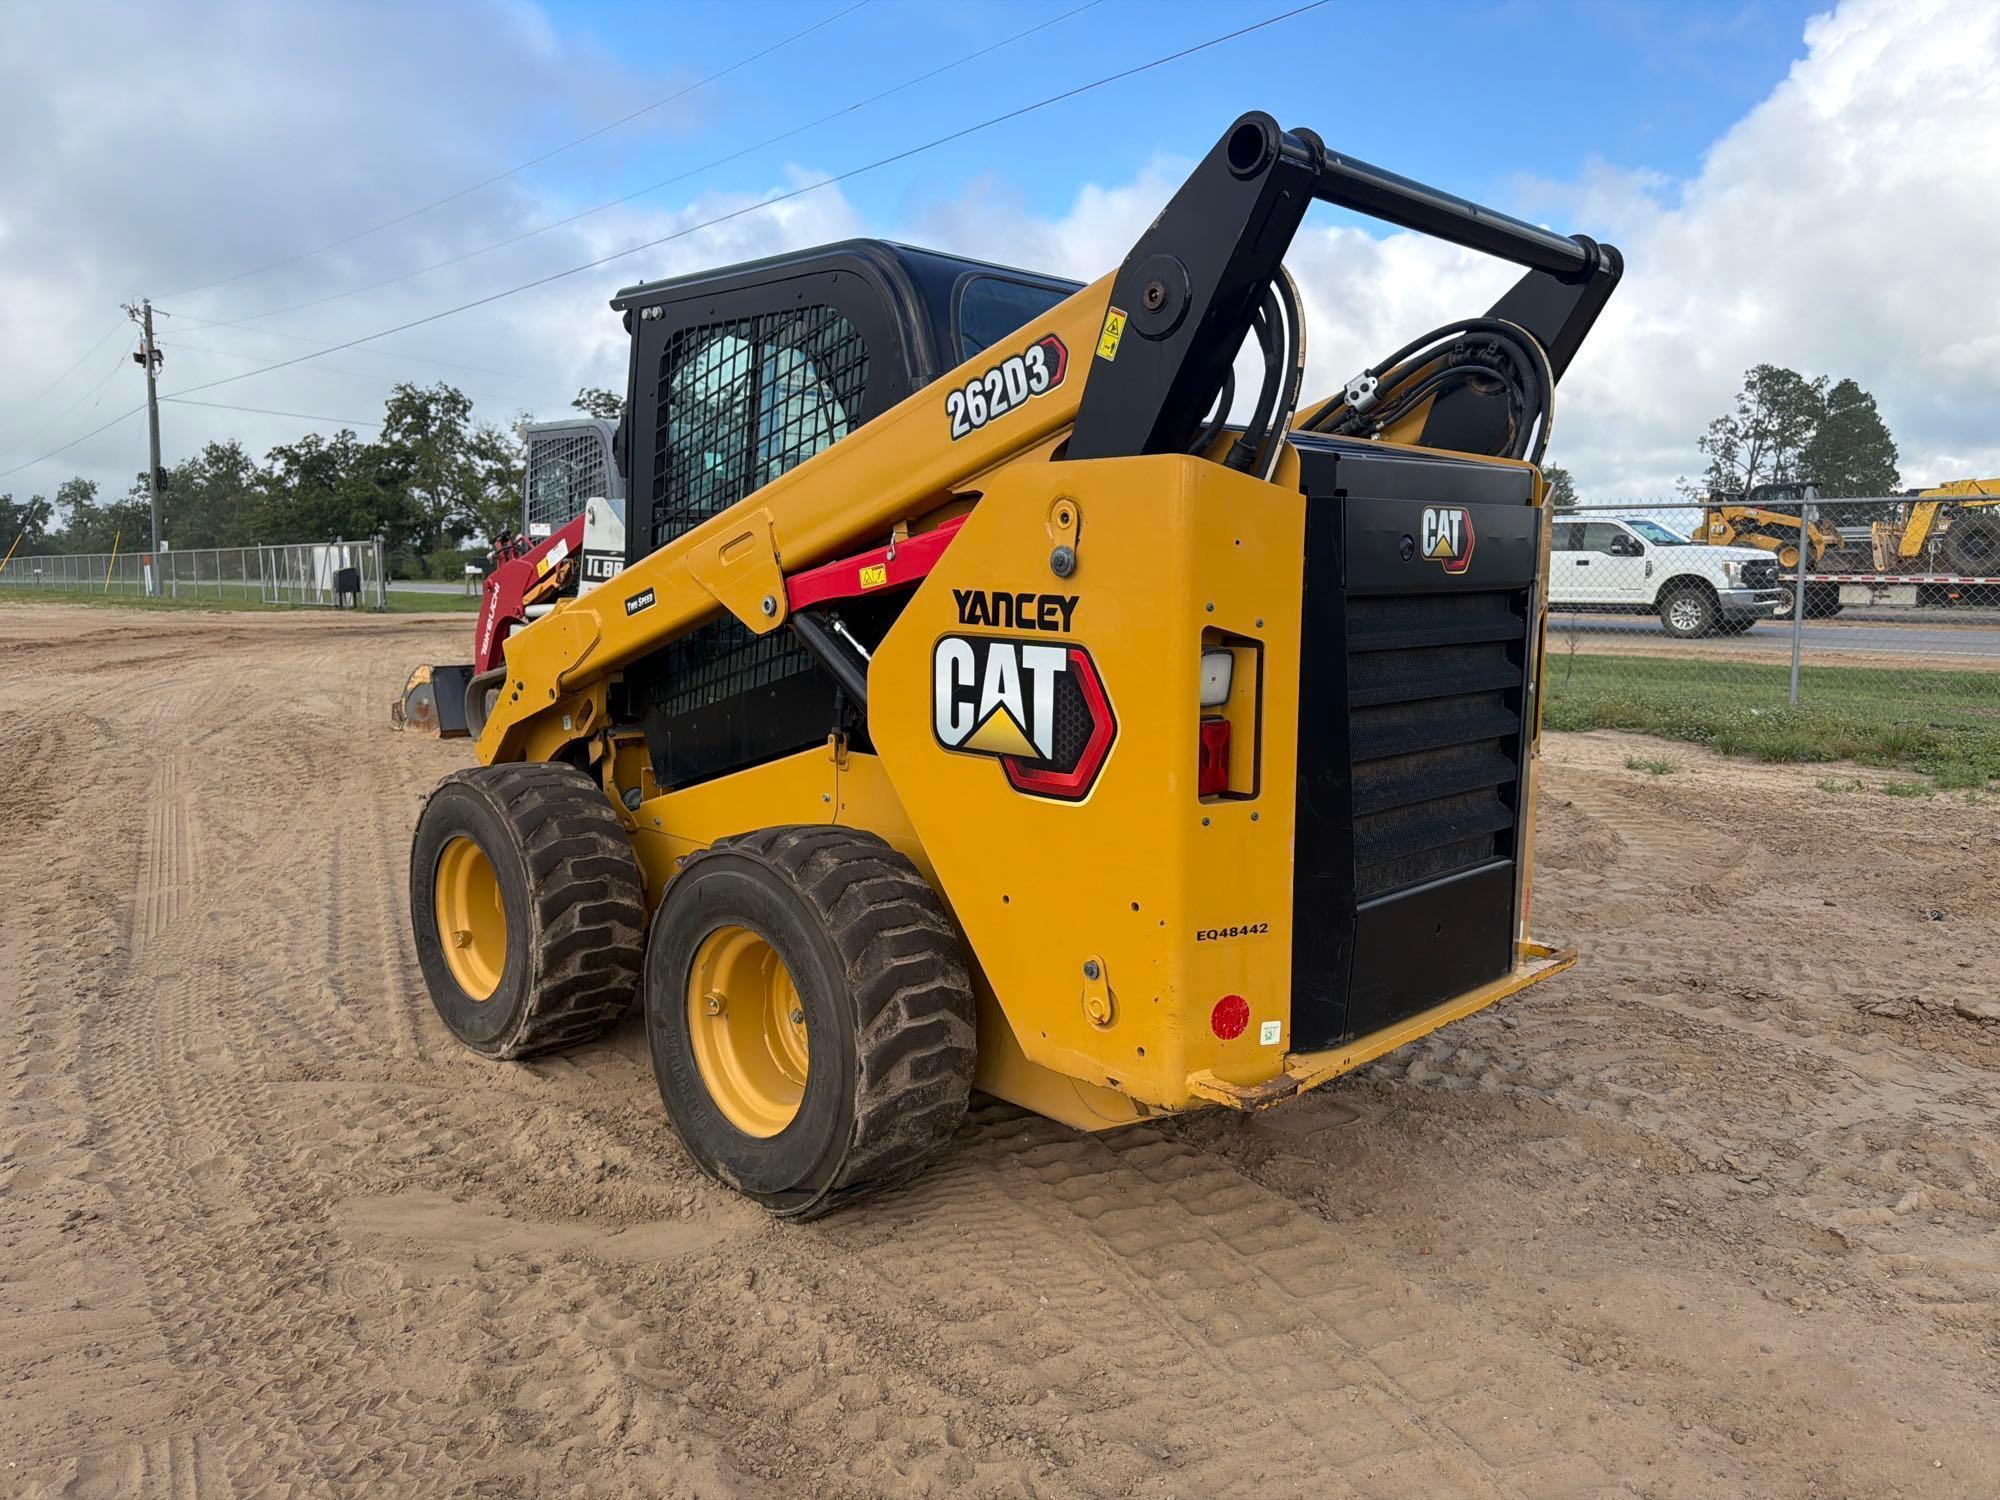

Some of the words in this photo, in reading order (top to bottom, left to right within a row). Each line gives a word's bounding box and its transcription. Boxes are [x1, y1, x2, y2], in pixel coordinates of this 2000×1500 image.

[947, 344, 1051, 438] 262D3
[1422, 508, 1463, 557] CAT
[480, 582, 500, 656] TAKEUCHI
[952, 588, 1080, 633] YANCEY
[935, 637, 1067, 761] CAT
[1196, 923, 1269, 941] EQ48442
